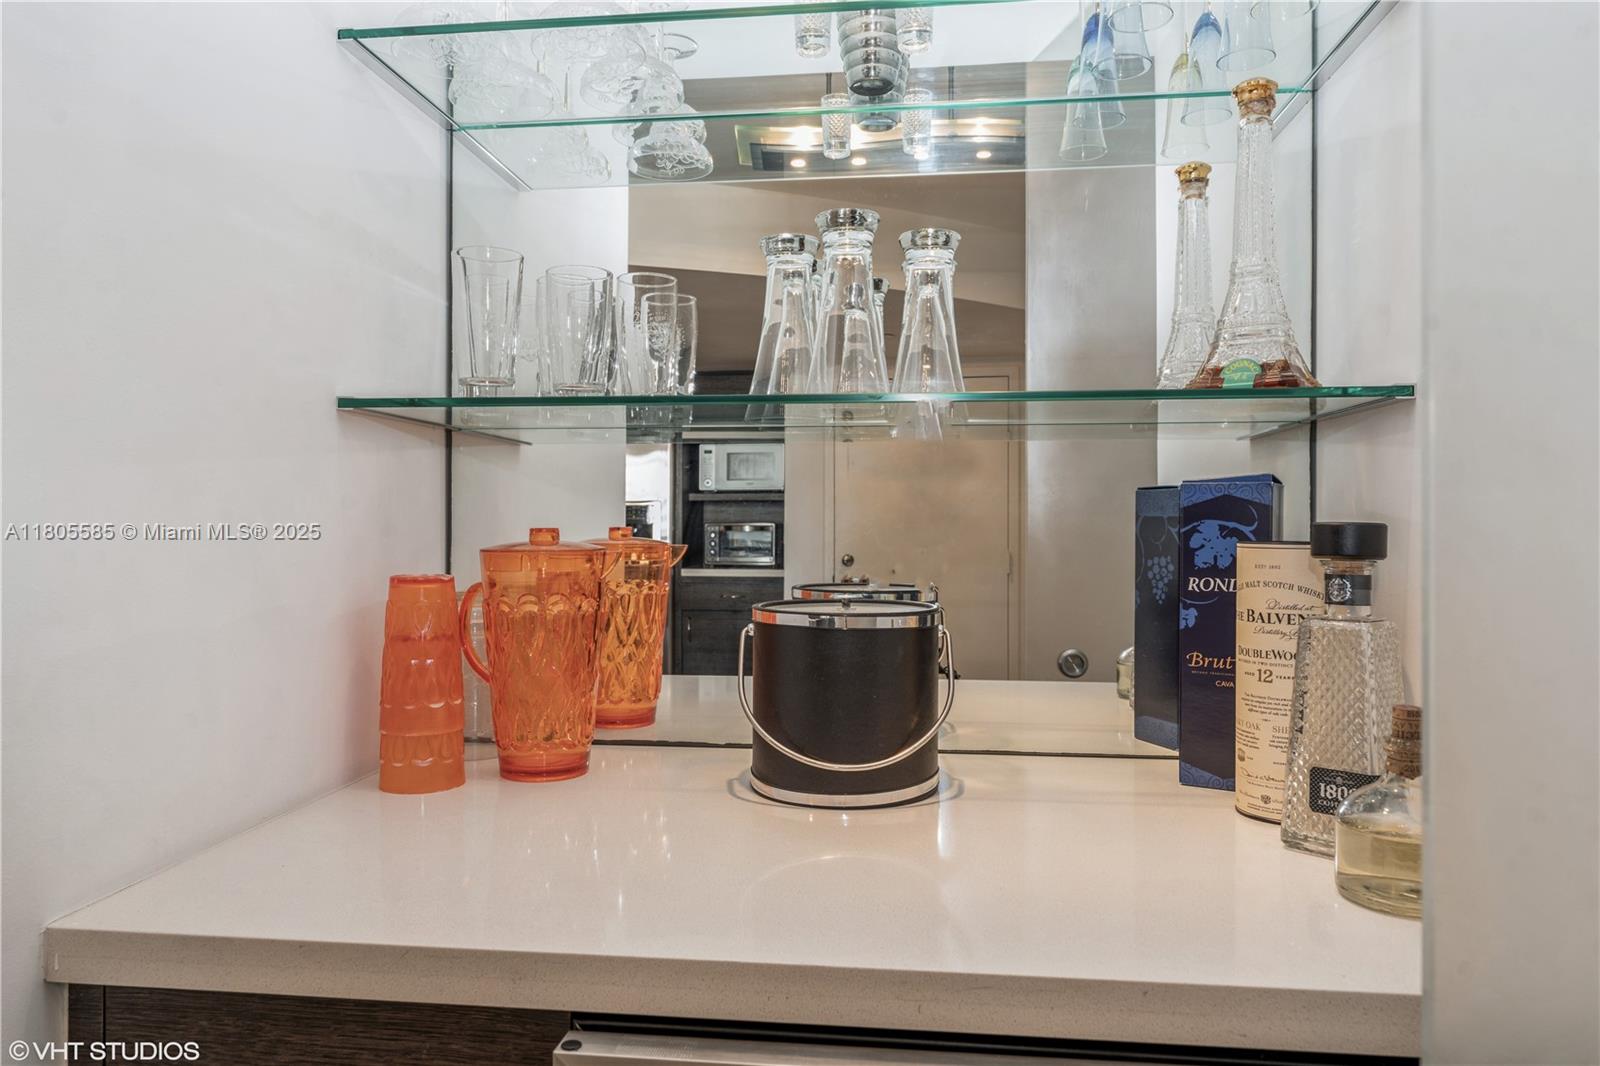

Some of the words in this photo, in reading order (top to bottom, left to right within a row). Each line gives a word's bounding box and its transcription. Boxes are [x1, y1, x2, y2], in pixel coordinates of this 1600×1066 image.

[1224, 360, 1259, 374] COGNAC
[1244, 579, 1260, 590] MALT
[1262, 580, 1295, 591] SCOTCH
[1186, 651, 1236, 670] Brut
[1257, 668, 1274, 684] 12
[1215, 680, 1235, 689] CAVA
[1319, 782, 1353, 801] 180
